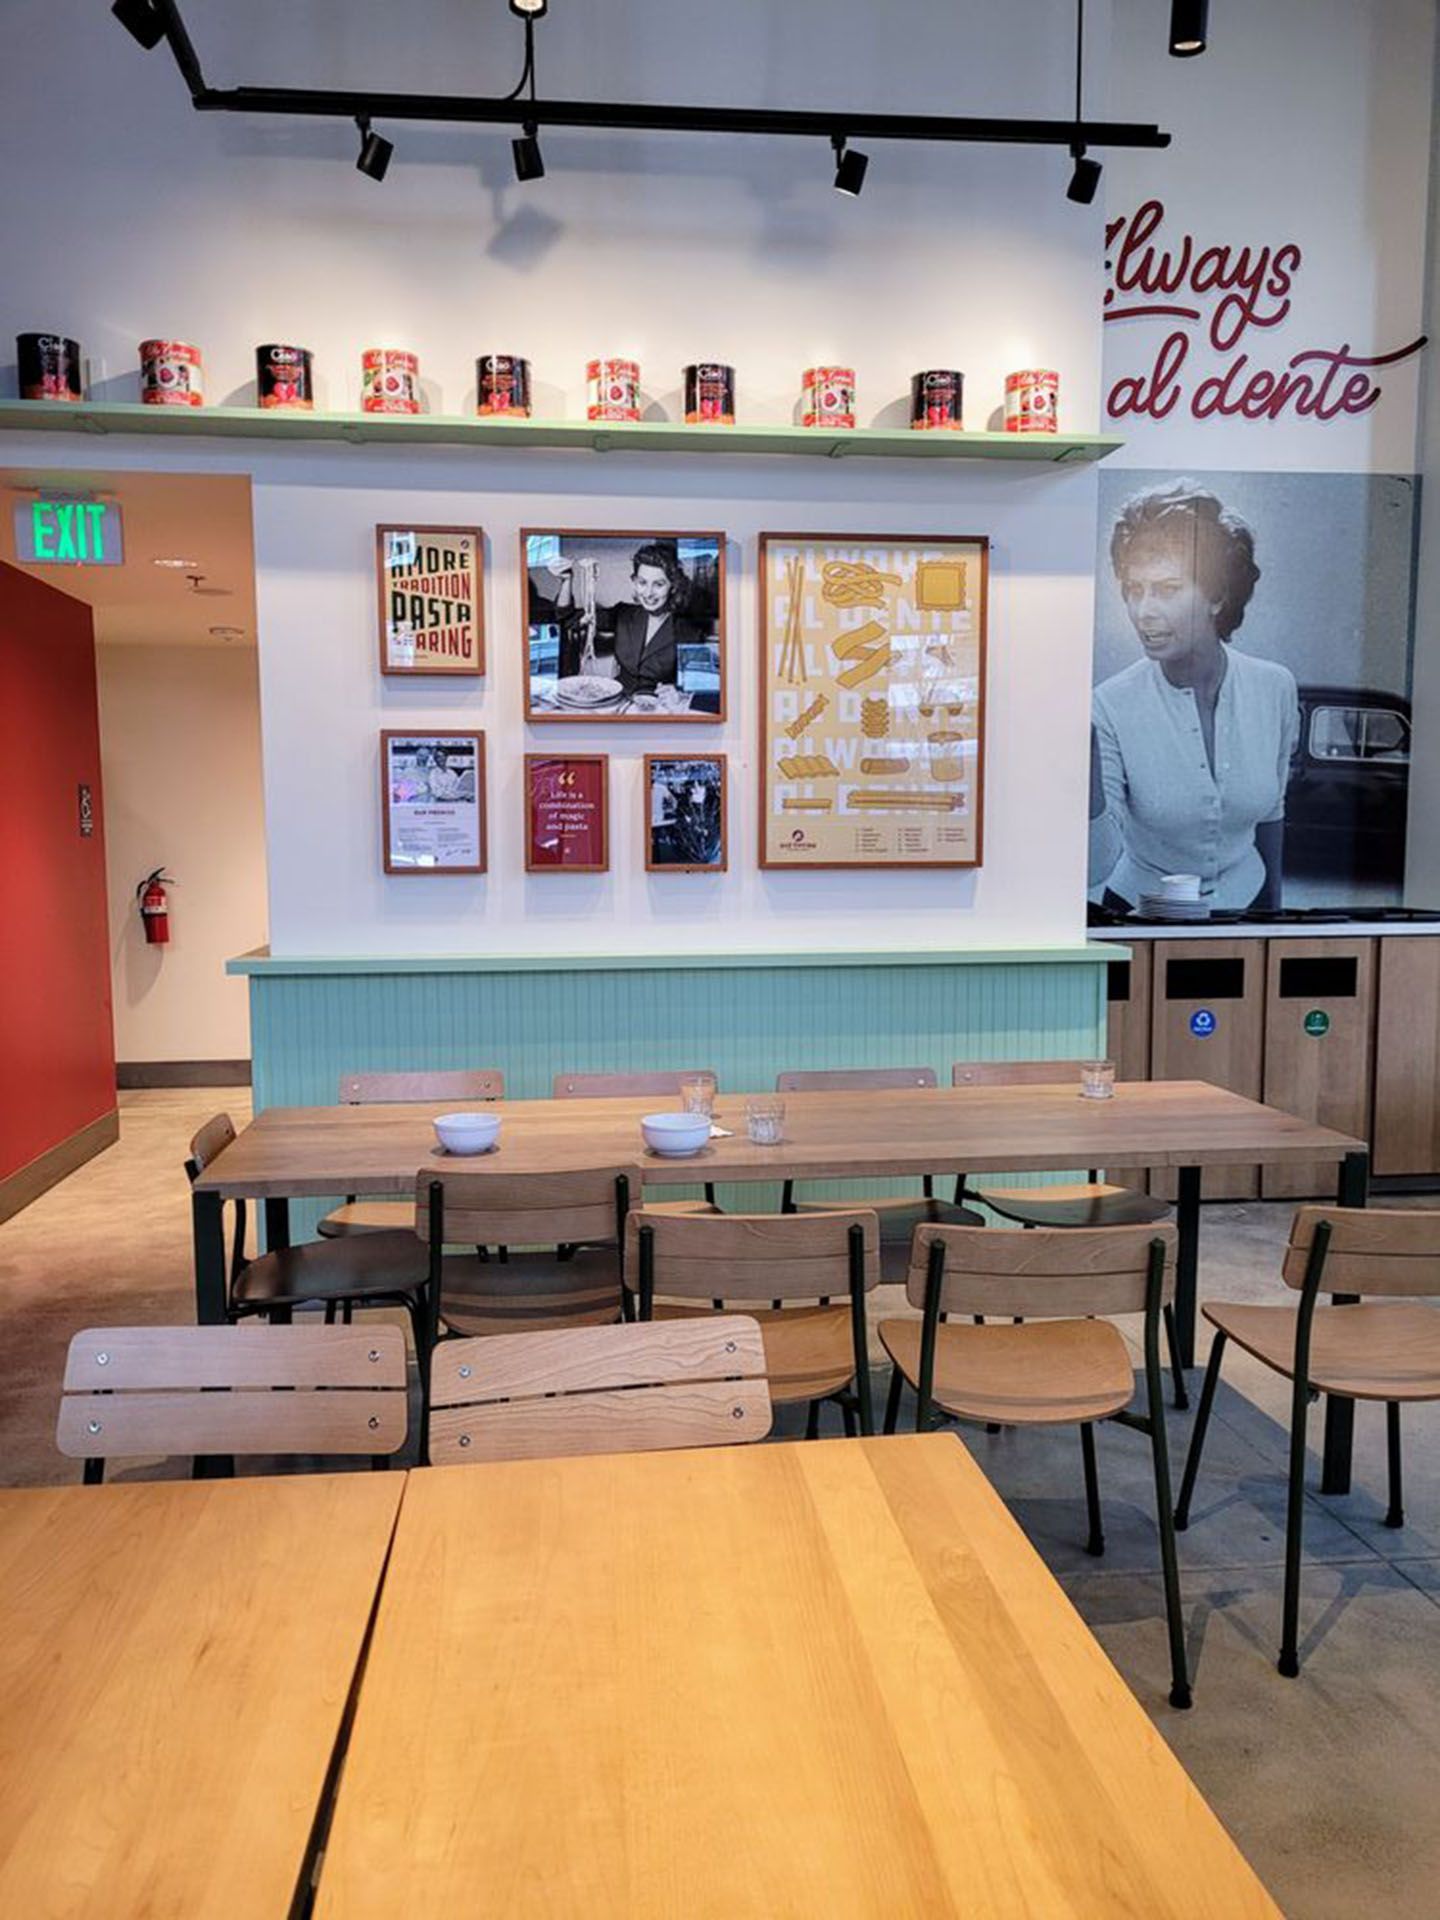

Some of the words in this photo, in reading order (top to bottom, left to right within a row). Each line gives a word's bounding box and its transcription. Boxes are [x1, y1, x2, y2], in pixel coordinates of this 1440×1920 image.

[1106, 331, 1189, 420] al
[1191, 335, 1429, 420] dente
[32, 501, 106, 562] EXIT
[391, 590, 471, 633] PASTA
[393, 572, 471, 600] TRADITION
